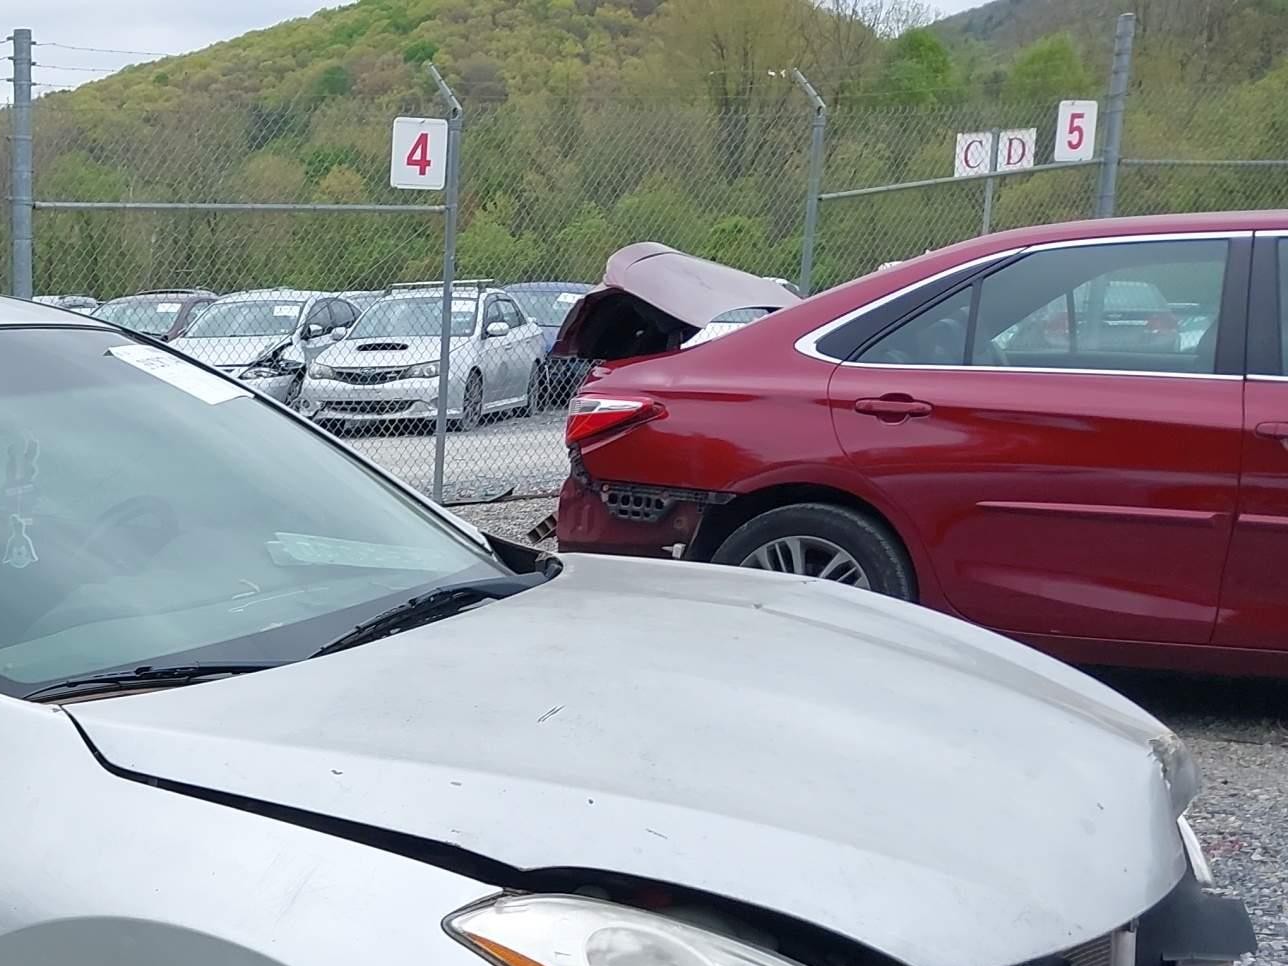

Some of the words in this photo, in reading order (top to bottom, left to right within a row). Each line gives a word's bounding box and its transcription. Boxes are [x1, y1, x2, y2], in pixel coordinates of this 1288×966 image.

[1067, 113, 1085, 150] 5
[406, 132, 431, 176] 4
[964, 139, 983, 169] C
[1006, 137, 1026, 166] D
